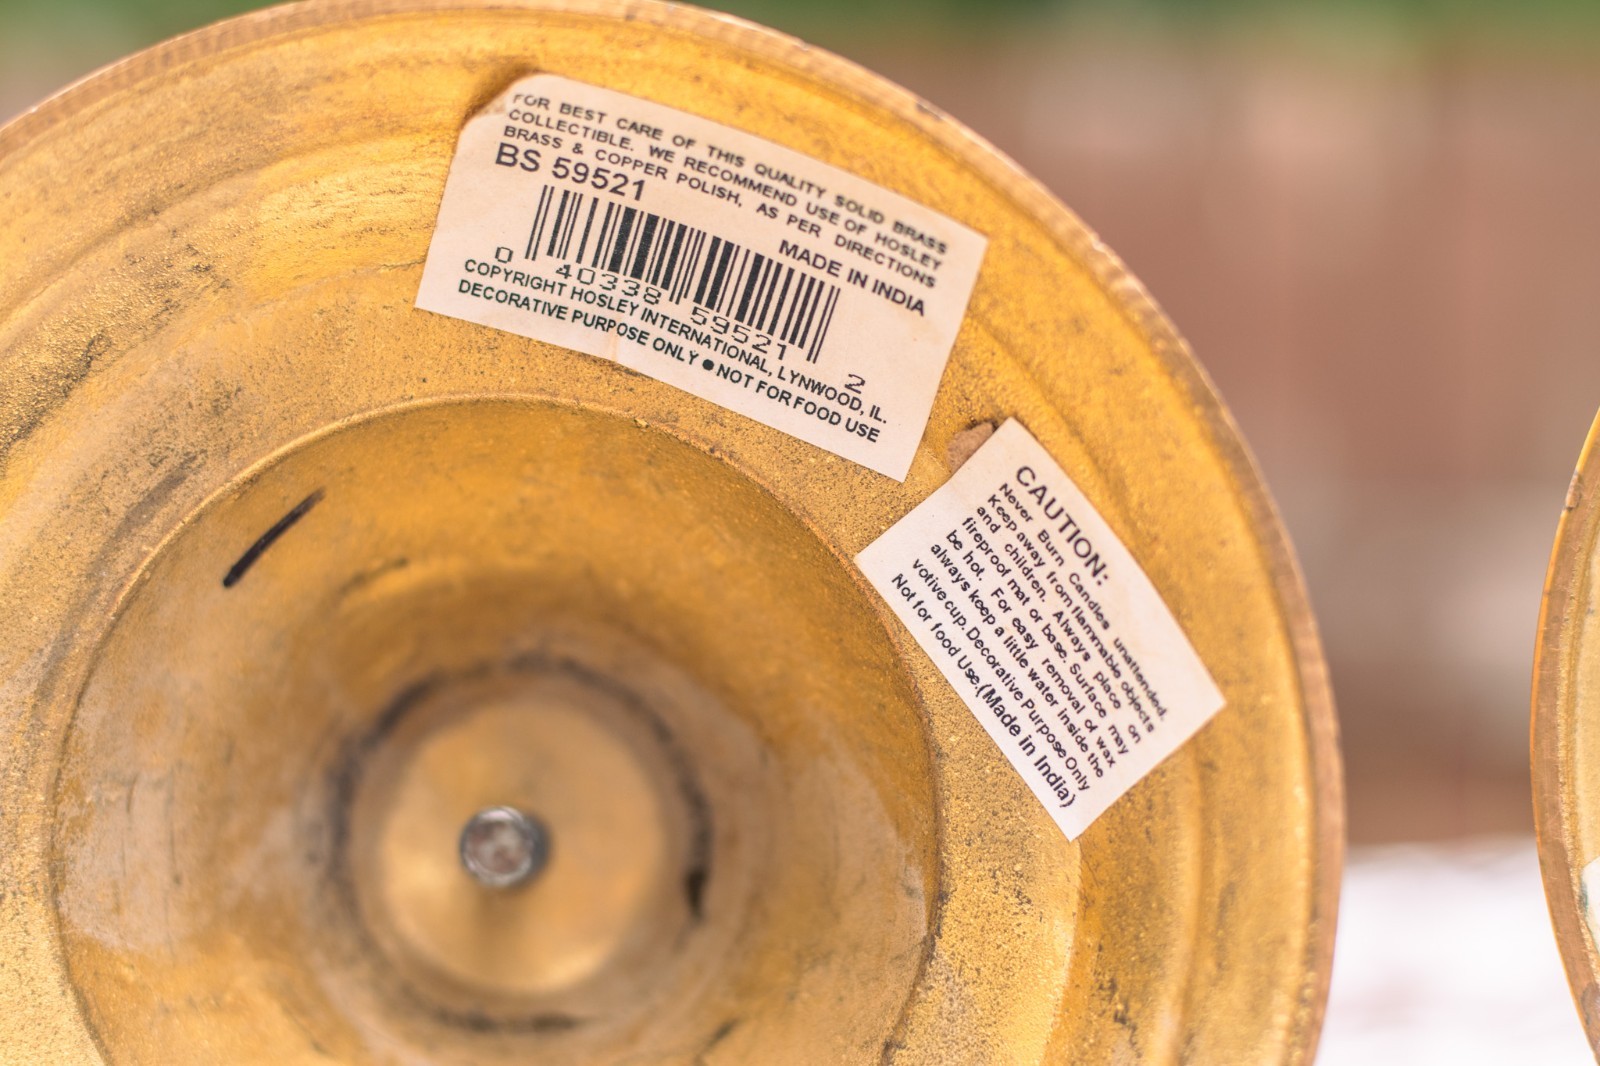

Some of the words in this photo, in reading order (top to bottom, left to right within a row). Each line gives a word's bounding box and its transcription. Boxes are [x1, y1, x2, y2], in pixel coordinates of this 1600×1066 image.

[494, 141, 542, 173] BS
[551, 156, 646, 202] 59521
[503, 125, 563, 149] BRASS
[571, 142, 584, 155] &
[595, 149, 668, 181] COPPER
[675, 172, 742, 208] POLISH,
[755, 202, 779, 220] AS
[786, 213, 822, 238] PER
[834, 234, 936, 288] DIRECTIONS
[508, 108, 634, 151] COLLECTIBLE.
[649, 144, 676, 164] WE
[683, 156, 798, 207] RECOMMEND
[805, 201, 840, 226] USE
[844, 219, 867, 235] OF
[874, 232, 942, 270] HOSLEY
[559, 102, 607, 124] BEST
[616, 117, 663, 141] CARE
[672, 134, 696, 149] OF
[707, 144, 745, 168] THIS
[754, 163, 827, 199] QUALITY
[835, 194, 885, 224] SOLID
[892, 220, 947, 254] BRASS
[458, 278, 569, 321] DECORATIVE
[571, 309, 651, 346] PURPOSE
[652, 337, 700, 366] ONLY
[715, 363, 755, 389] NOT
[755, 379, 793, 407] FOR
[792, 395, 842, 426] FOOD
[844, 417, 881, 443] USE
[464, 258, 568, 297] COPYRIGHT
[569, 285, 640, 317] HOSLEY
[640, 307, 773, 378] INTERNATIONAL,
[776, 365, 865, 416] LYNWOOD,
[868, 404, 887, 424] IL.
[494, 246, 514, 264] 0
[555, 264, 663, 306] 40338
[689, 305, 788, 361] 59521
[843, 373, 866, 395] 2
[778, 239, 843, 278] MADE
[846, 268, 869, 289] IN
[871, 278, 925, 317] INDIA
[998, 482, 1034, 523] Never
[1037, 528, 1065, 567] Burn
[1068, 572, 1110, 631] Candles
[1016, 465, 1109, 586] CAUTION:
[891, 573, 917, 602] Not
[912, 599, 933, 623] for
[930, 622, 962, 658] food
[1018, 734, 1036, 757] in
[1033, 754, 1076, 808] India)
[912, 558, 947, 601] votive
[944, 600, 967, 631] cup.
[965, 626, 1024, 701] Decorative
[1020, 697, 1067, 759] Purpose
[1064, 756, 1091, 791] Only
[930, 544, 971, 592] always
[967, 588, 996, 626] keep
[994, 626, 1005, 638] a
[1002, 635, 1029, 669] little
[1027, 667, 1059, 707] water
[1056, 707, 1089, 753] inside
[1087, 752, 1104, 778] the
[945, 529, 963, 551] be
[962, 550, 986, 582] hot.
[990, 586, 1013, 614] For
[1011, 617, 1040, 650] easy
[1041, 657, 1086, 715] removal
[1084, 718, 1099, 734] of
[1096, 736, 1116, 768] wax
[961, 516, 1012, 578] fireproof
[1006, 578, 1031, 607] mat
[1029, 608, 1044, 624] or
[1041, 622, 1068, 664] base.
[1069, 662, 1107, 719] Surface
[1107, 724, 1129, 755] may
[976, 506, 1002, 534] and
[1004, 543, 1047, 603] children.
[1052, 610, 1091, 662] Always
[1092, 671, 1122, 710] place
[1128, 724, 1141, 744] on
[987, 493, 1018, 532] Keep
[1016, 532, 1046, 568] away
[1046, 570, 1073, 608] from
[1071, 605, 1122, 679] flammable
[1120, 681, 1155, 733] objects
